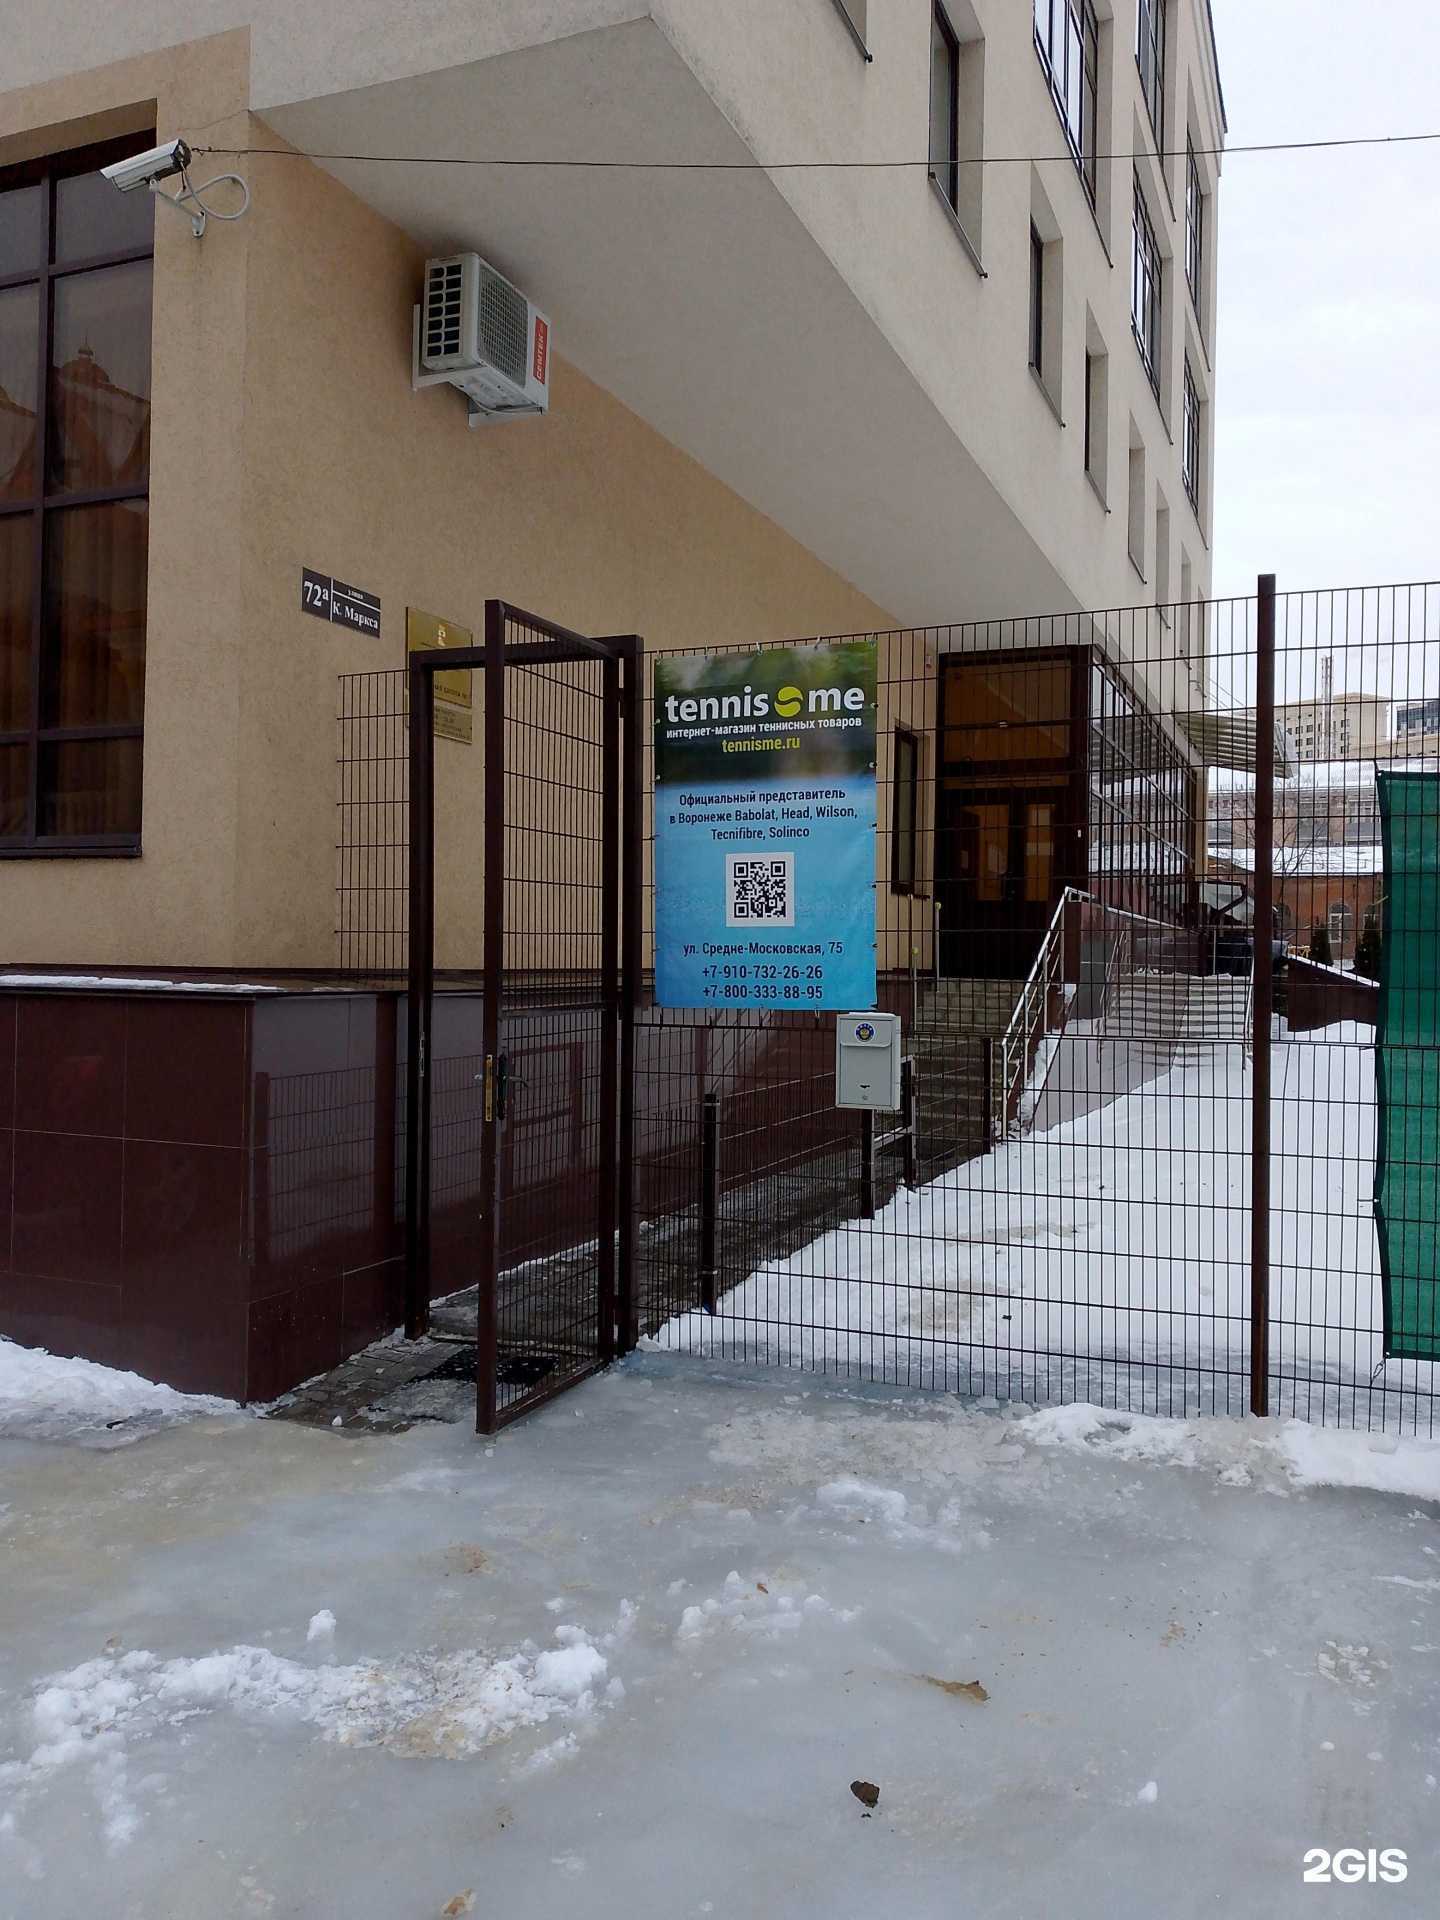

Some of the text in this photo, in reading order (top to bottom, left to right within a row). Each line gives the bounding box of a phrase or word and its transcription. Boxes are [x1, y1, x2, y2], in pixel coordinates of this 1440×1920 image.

[304, 581, 329, 607] 72а
[333, 601, 378, 629] К. Маркса
[665, 685, 865, 723] tennis me
[666, 717, 862, 739] интернет-магазин теннисных товаров
[721, 735, 801, 754] tennisme.ru
[679, 788, 846, 807] Официальный представитель
[669, 805, 858, 825] в Воронеже Babolat, Head, Wilson,
[711, 826, 810, 841] Tecnifibre, Solinco
[683, 941, 843, 957] ул. Средне-Московская, 75
[702, 964, 823, 980] +7-910-732-26-26
[702, 985, 823, 1000] +7-800-333-88-95
